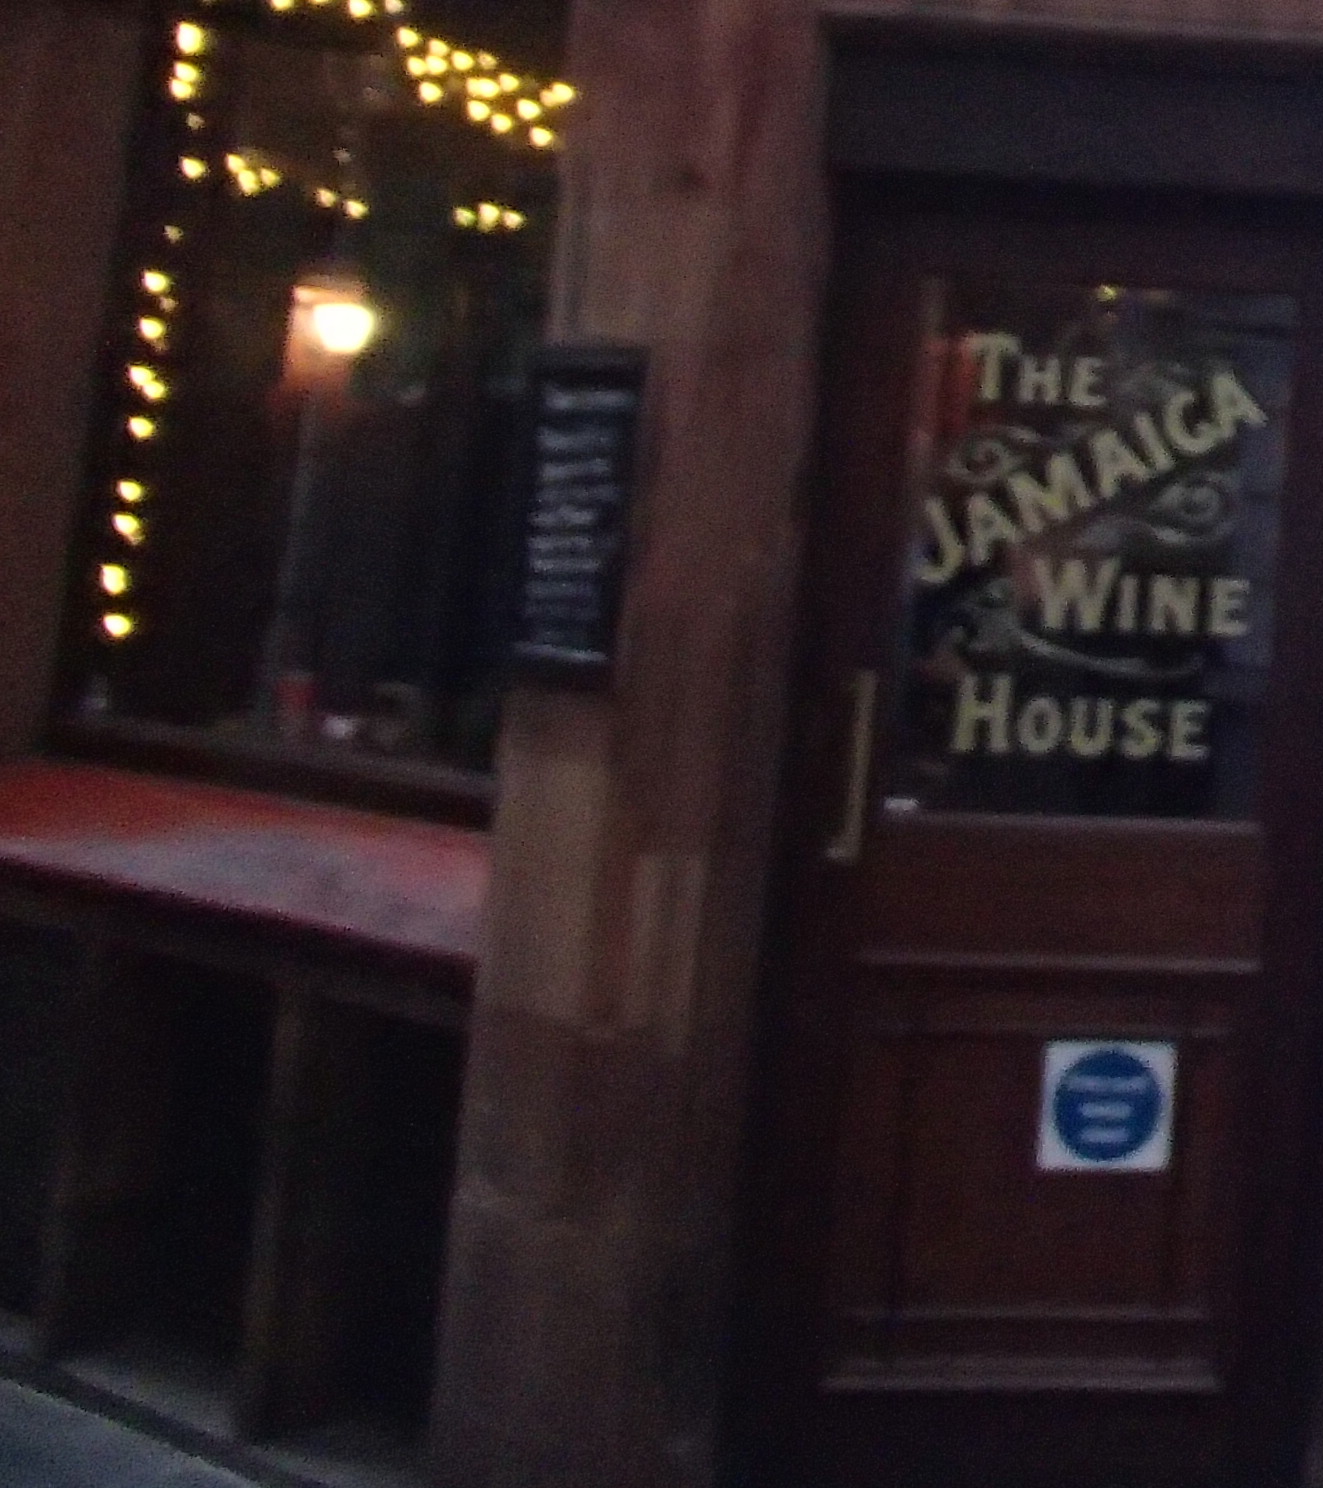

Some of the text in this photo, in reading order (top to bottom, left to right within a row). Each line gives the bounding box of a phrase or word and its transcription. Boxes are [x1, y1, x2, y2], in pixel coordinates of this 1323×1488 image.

[966, 331, 1107, 407] THE
[917, 369, 1268, 584] JAMAICA
[1034, 557, 1251, 636] WINE
[950, 673, 1211, 761] HOUSE
